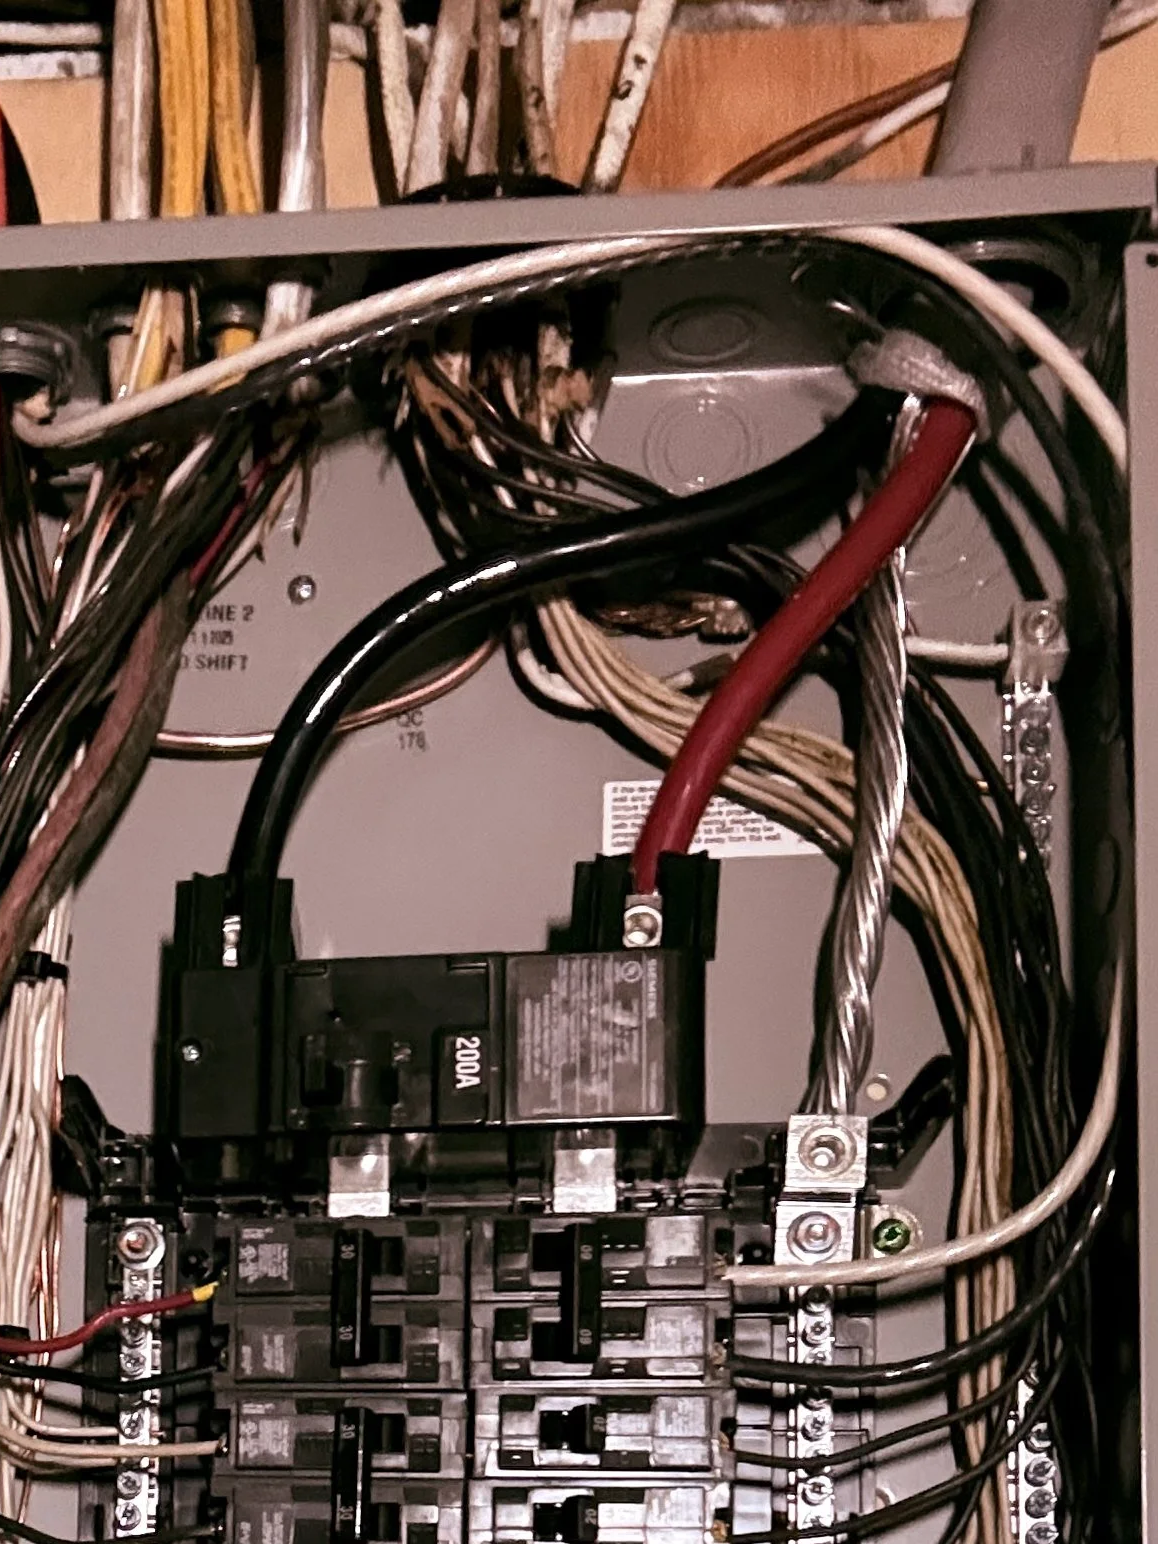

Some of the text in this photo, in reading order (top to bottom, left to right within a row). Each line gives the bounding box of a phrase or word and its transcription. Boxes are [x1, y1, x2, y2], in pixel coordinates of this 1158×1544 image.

[242, 604, 255, 622] 2
[195, 653, 249, 671] SHIFT
[646, 958, 657, 1019] SIEMENS
[454, 1035, 482, 1090] 200A
[340, 1244, 355, 1260] 30
[338, 1325, 353, 1341] 30
[340, 1423, 356, 1439] 30
